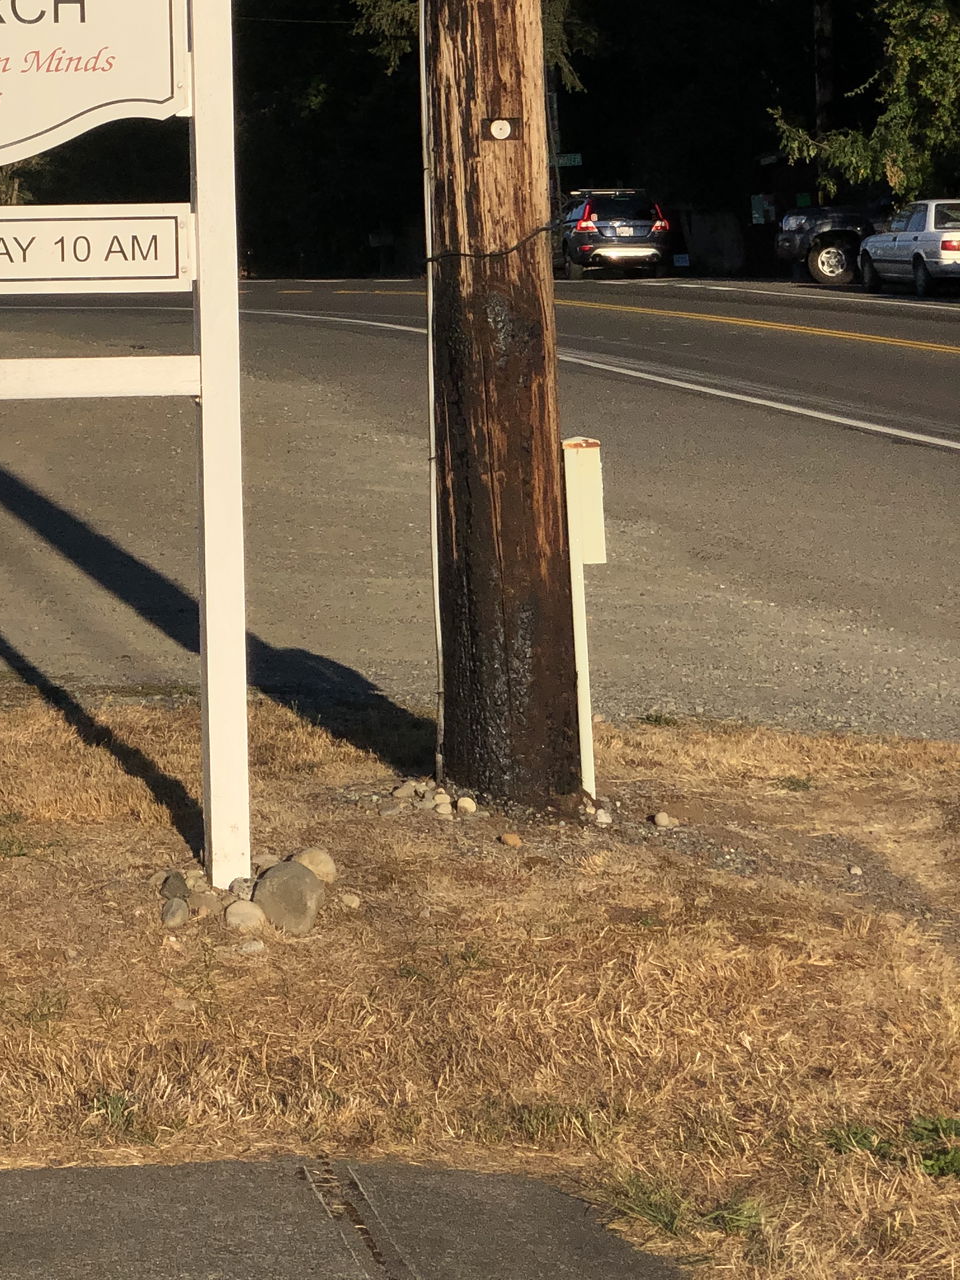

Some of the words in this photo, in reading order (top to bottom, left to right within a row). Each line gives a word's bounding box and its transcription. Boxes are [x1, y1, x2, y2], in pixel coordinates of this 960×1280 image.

[20, 47, 116, 74] Minds
[54, 235, 91, 263] 10
[104, 234, 159, 262] AM
